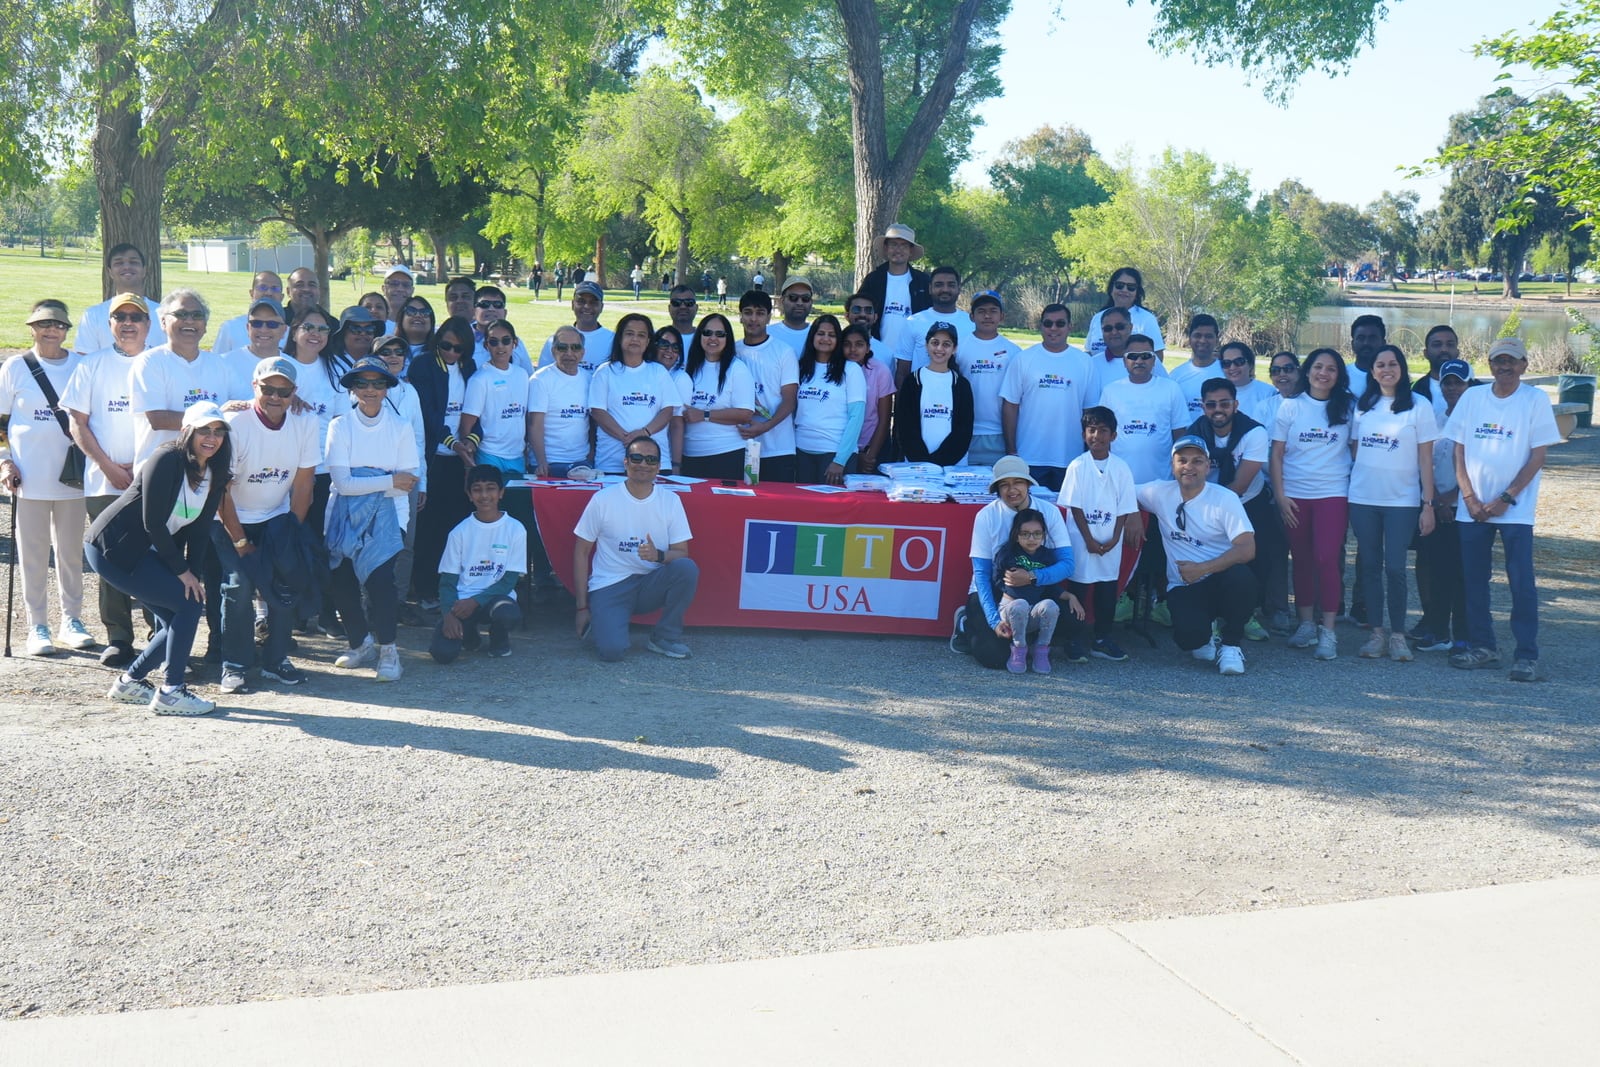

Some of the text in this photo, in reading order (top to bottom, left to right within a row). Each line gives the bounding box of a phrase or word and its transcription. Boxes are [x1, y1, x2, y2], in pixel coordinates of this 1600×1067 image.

[622, 393, 648, 401] AHIMSA
[560, 406, 585, 414] AHIMSA
[924, 407, 949, 415] AHIMSA
[1299, 431, 1328, 439] AHIMSA
[1362, 436, 1389, 444] AHIMSA
[762, 530, 935, 576] JITO
[469, 562, 495, 572] AHIMSA
[806, 583, 873, 613] USA
